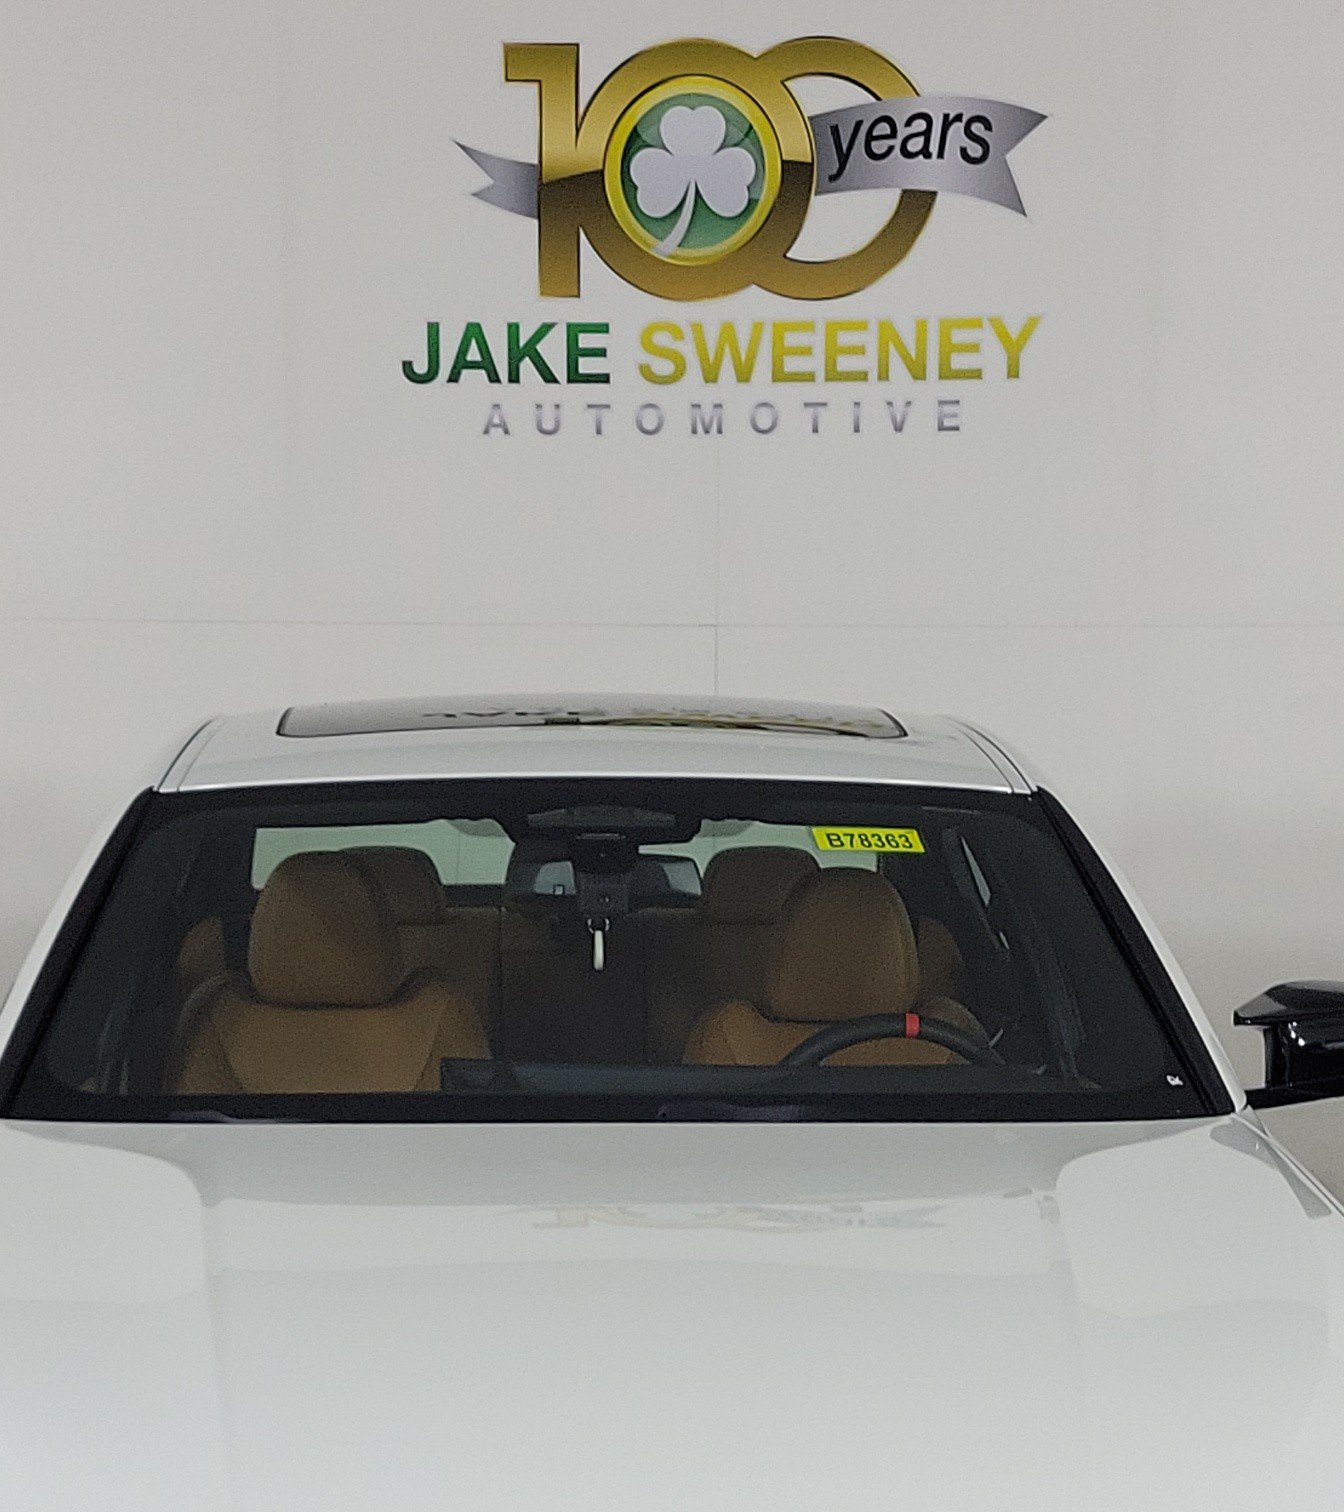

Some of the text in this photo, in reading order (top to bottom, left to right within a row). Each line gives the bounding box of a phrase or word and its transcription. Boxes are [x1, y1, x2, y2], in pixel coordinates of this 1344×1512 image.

[502, 36, 993, 301] 100 years
[402, 316, 1042, 386] JAKE SWEENEY
[482, 400, 962, 436] AUTOMOTIVE
[826, 833, 913, 848] B78363
